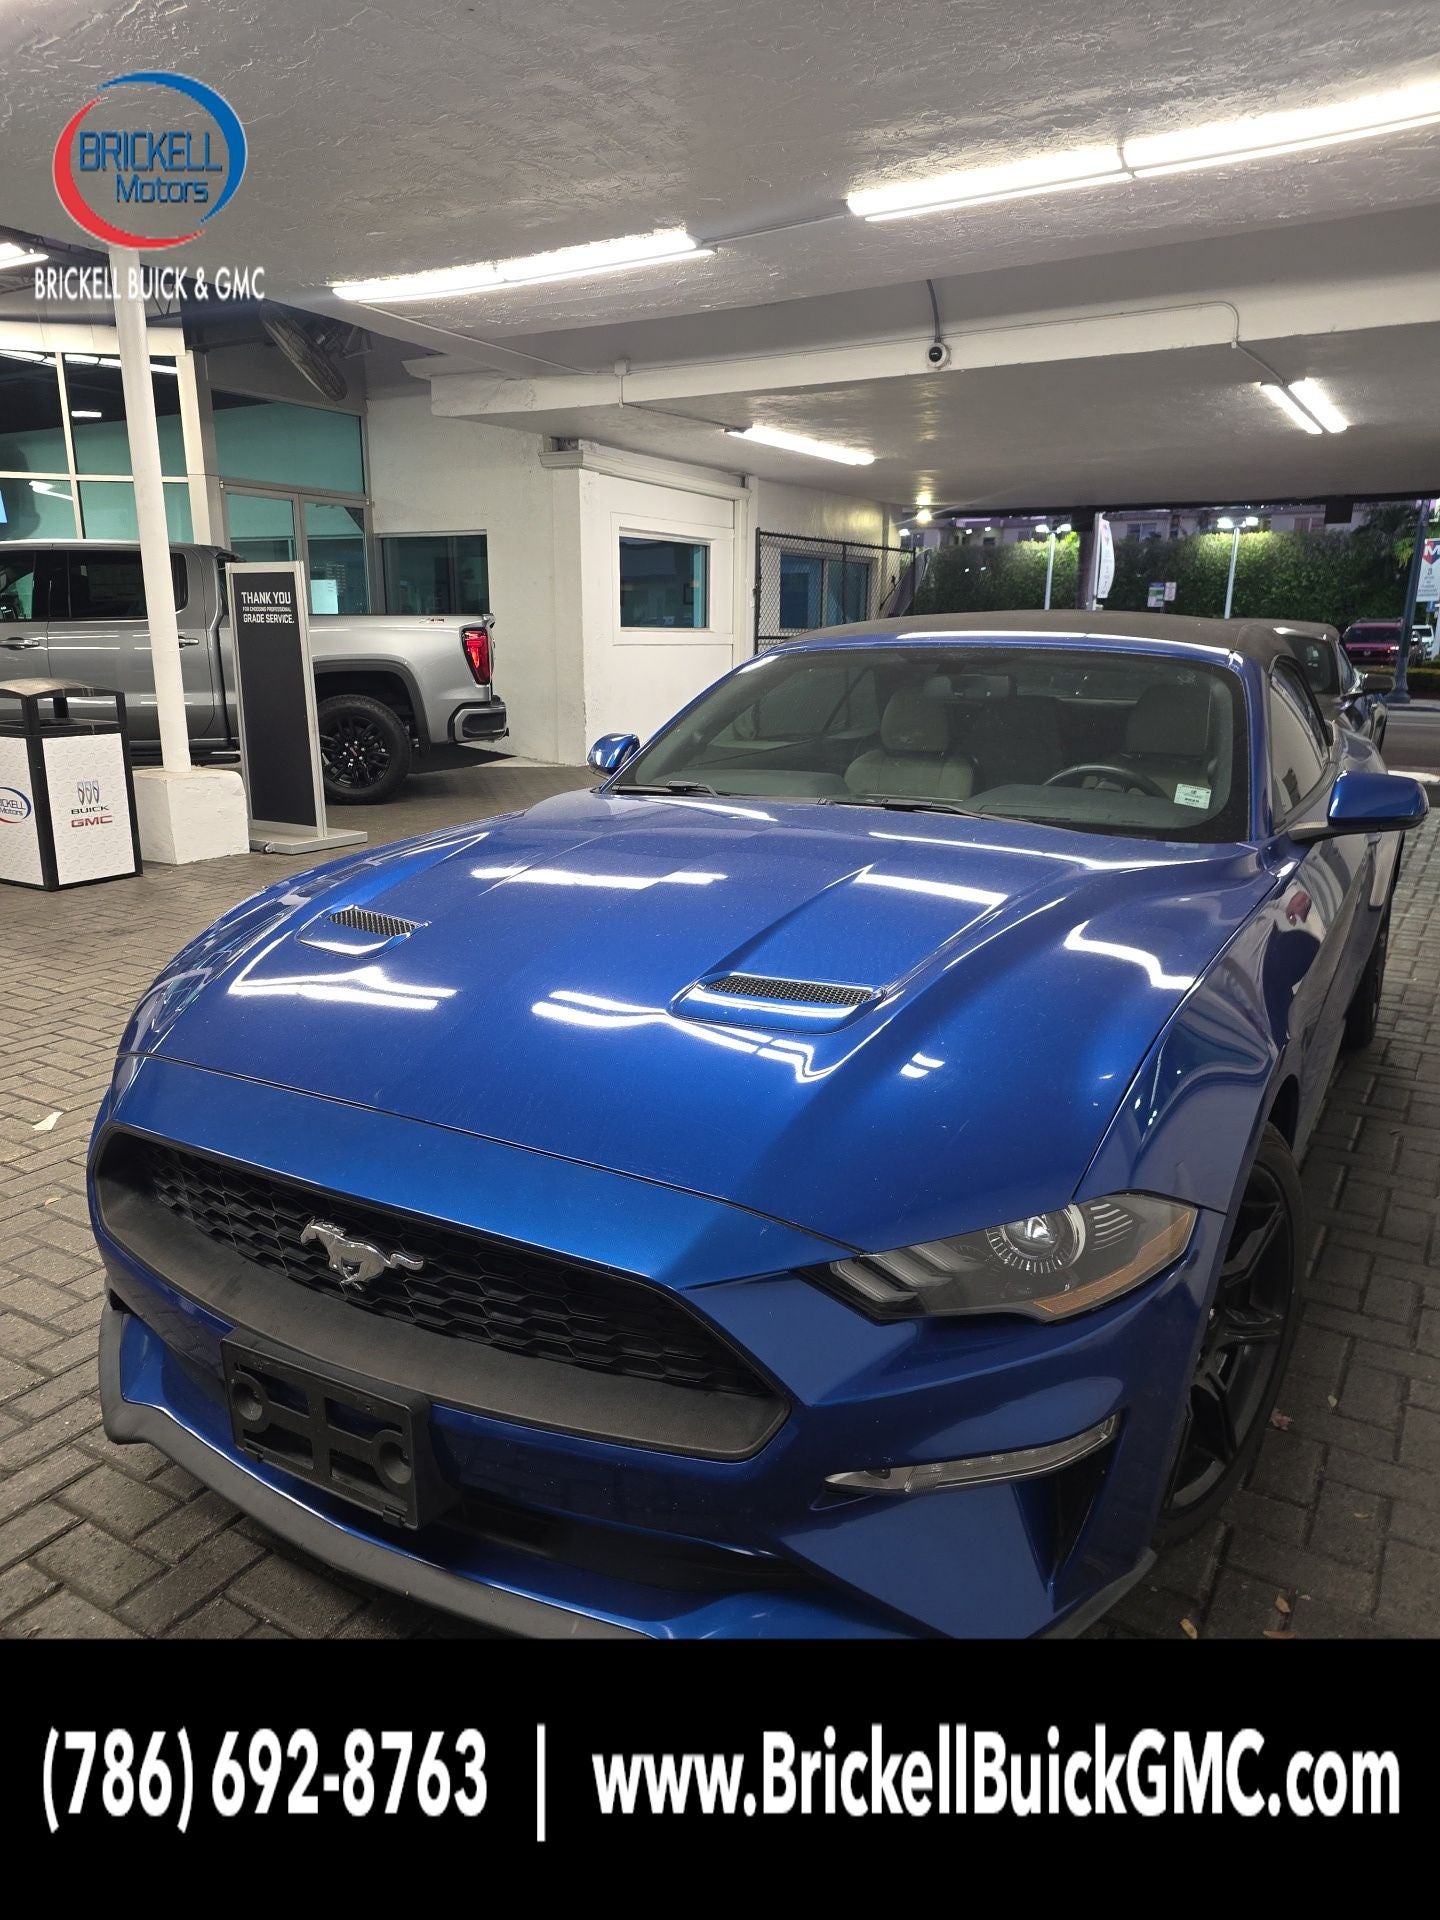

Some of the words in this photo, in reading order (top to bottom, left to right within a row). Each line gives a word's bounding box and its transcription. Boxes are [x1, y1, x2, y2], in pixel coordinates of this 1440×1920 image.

[241, 591, 272, 604] THANK
[273, 591, 291, 604] YOU
[243, 613, 265, 623] GRADE
[265, 614, 295, 624] SERVICE.
[71, 805, 109, 815] BUICK
[72, 815, 113, 828] GMC
